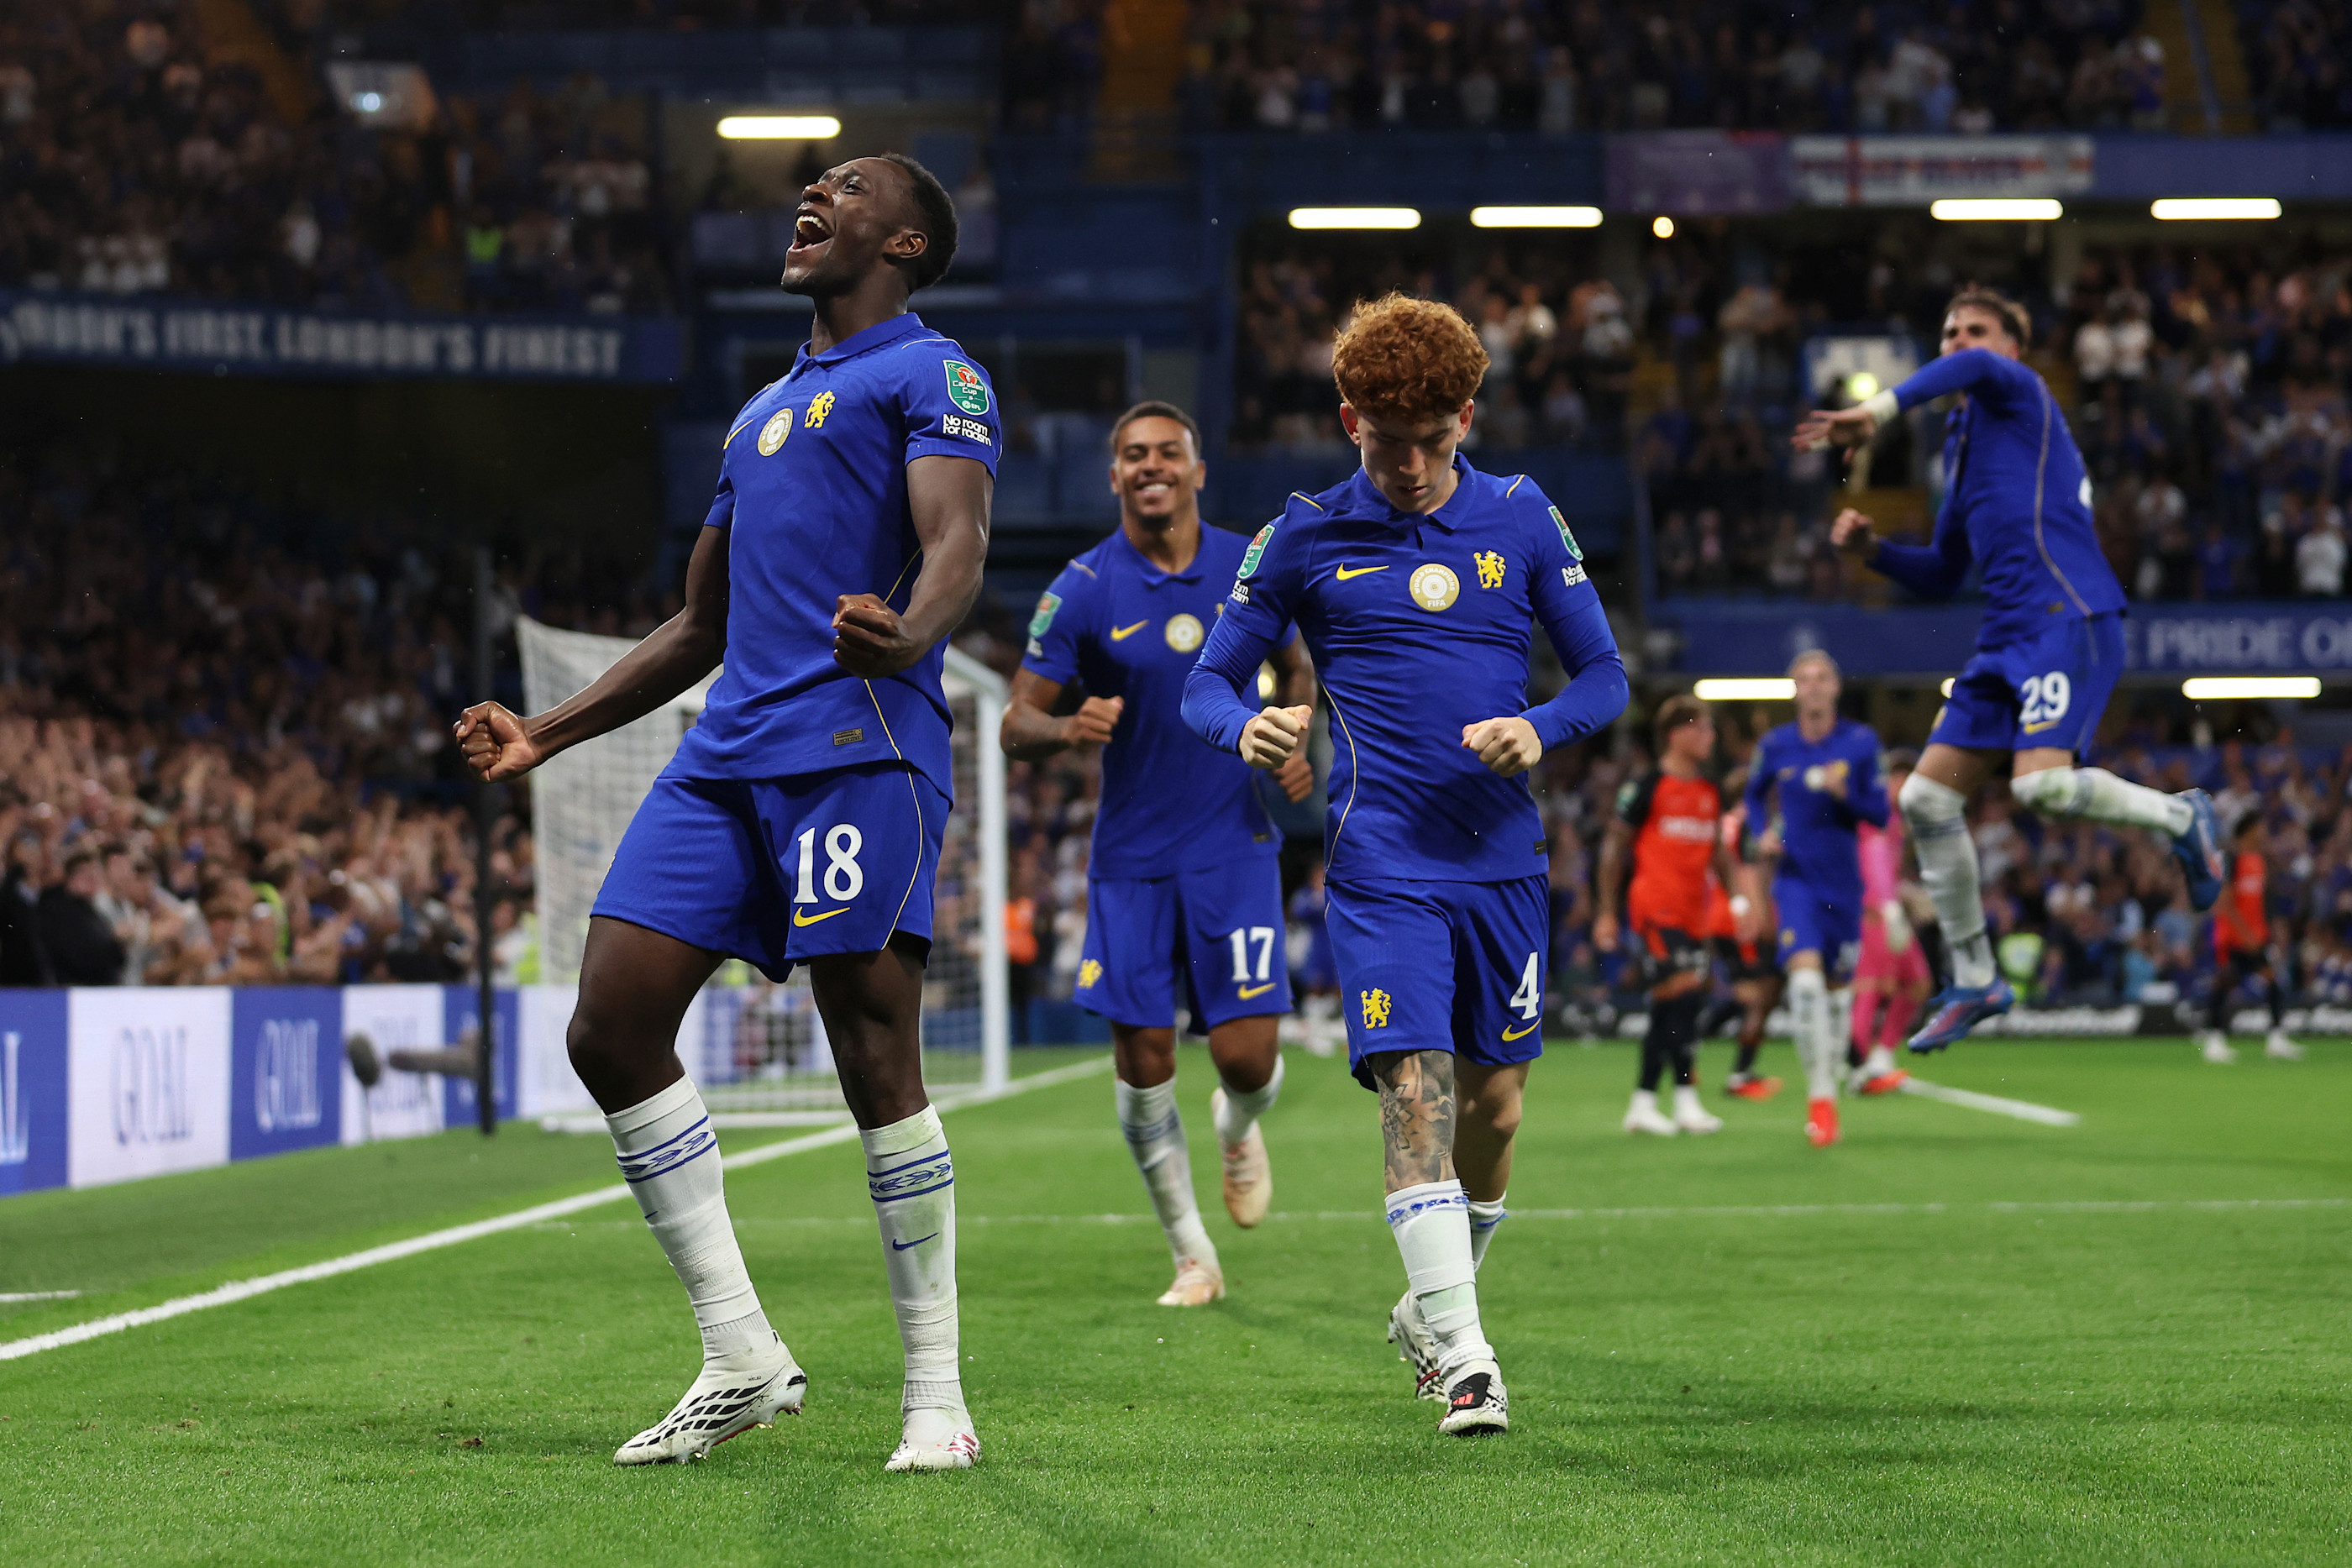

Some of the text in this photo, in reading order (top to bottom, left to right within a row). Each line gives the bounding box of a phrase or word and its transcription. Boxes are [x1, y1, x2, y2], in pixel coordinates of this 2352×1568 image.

[953, 380, 984, 391] Carabao
[963, 387, 978, 396] Cup
[942, 413, 989, 438] No room
[961, 427, 992, 447] racism
[1427, 599, 1446, 608] FIFA
[2148, 617, 2294, 668] PRIDE
[2019, 671, 2071, 724] 29
[793, 823, 864, 904] 18
[1228, 926, 1276, 983] 17
[1509, 951, 1541, 1020] 4
